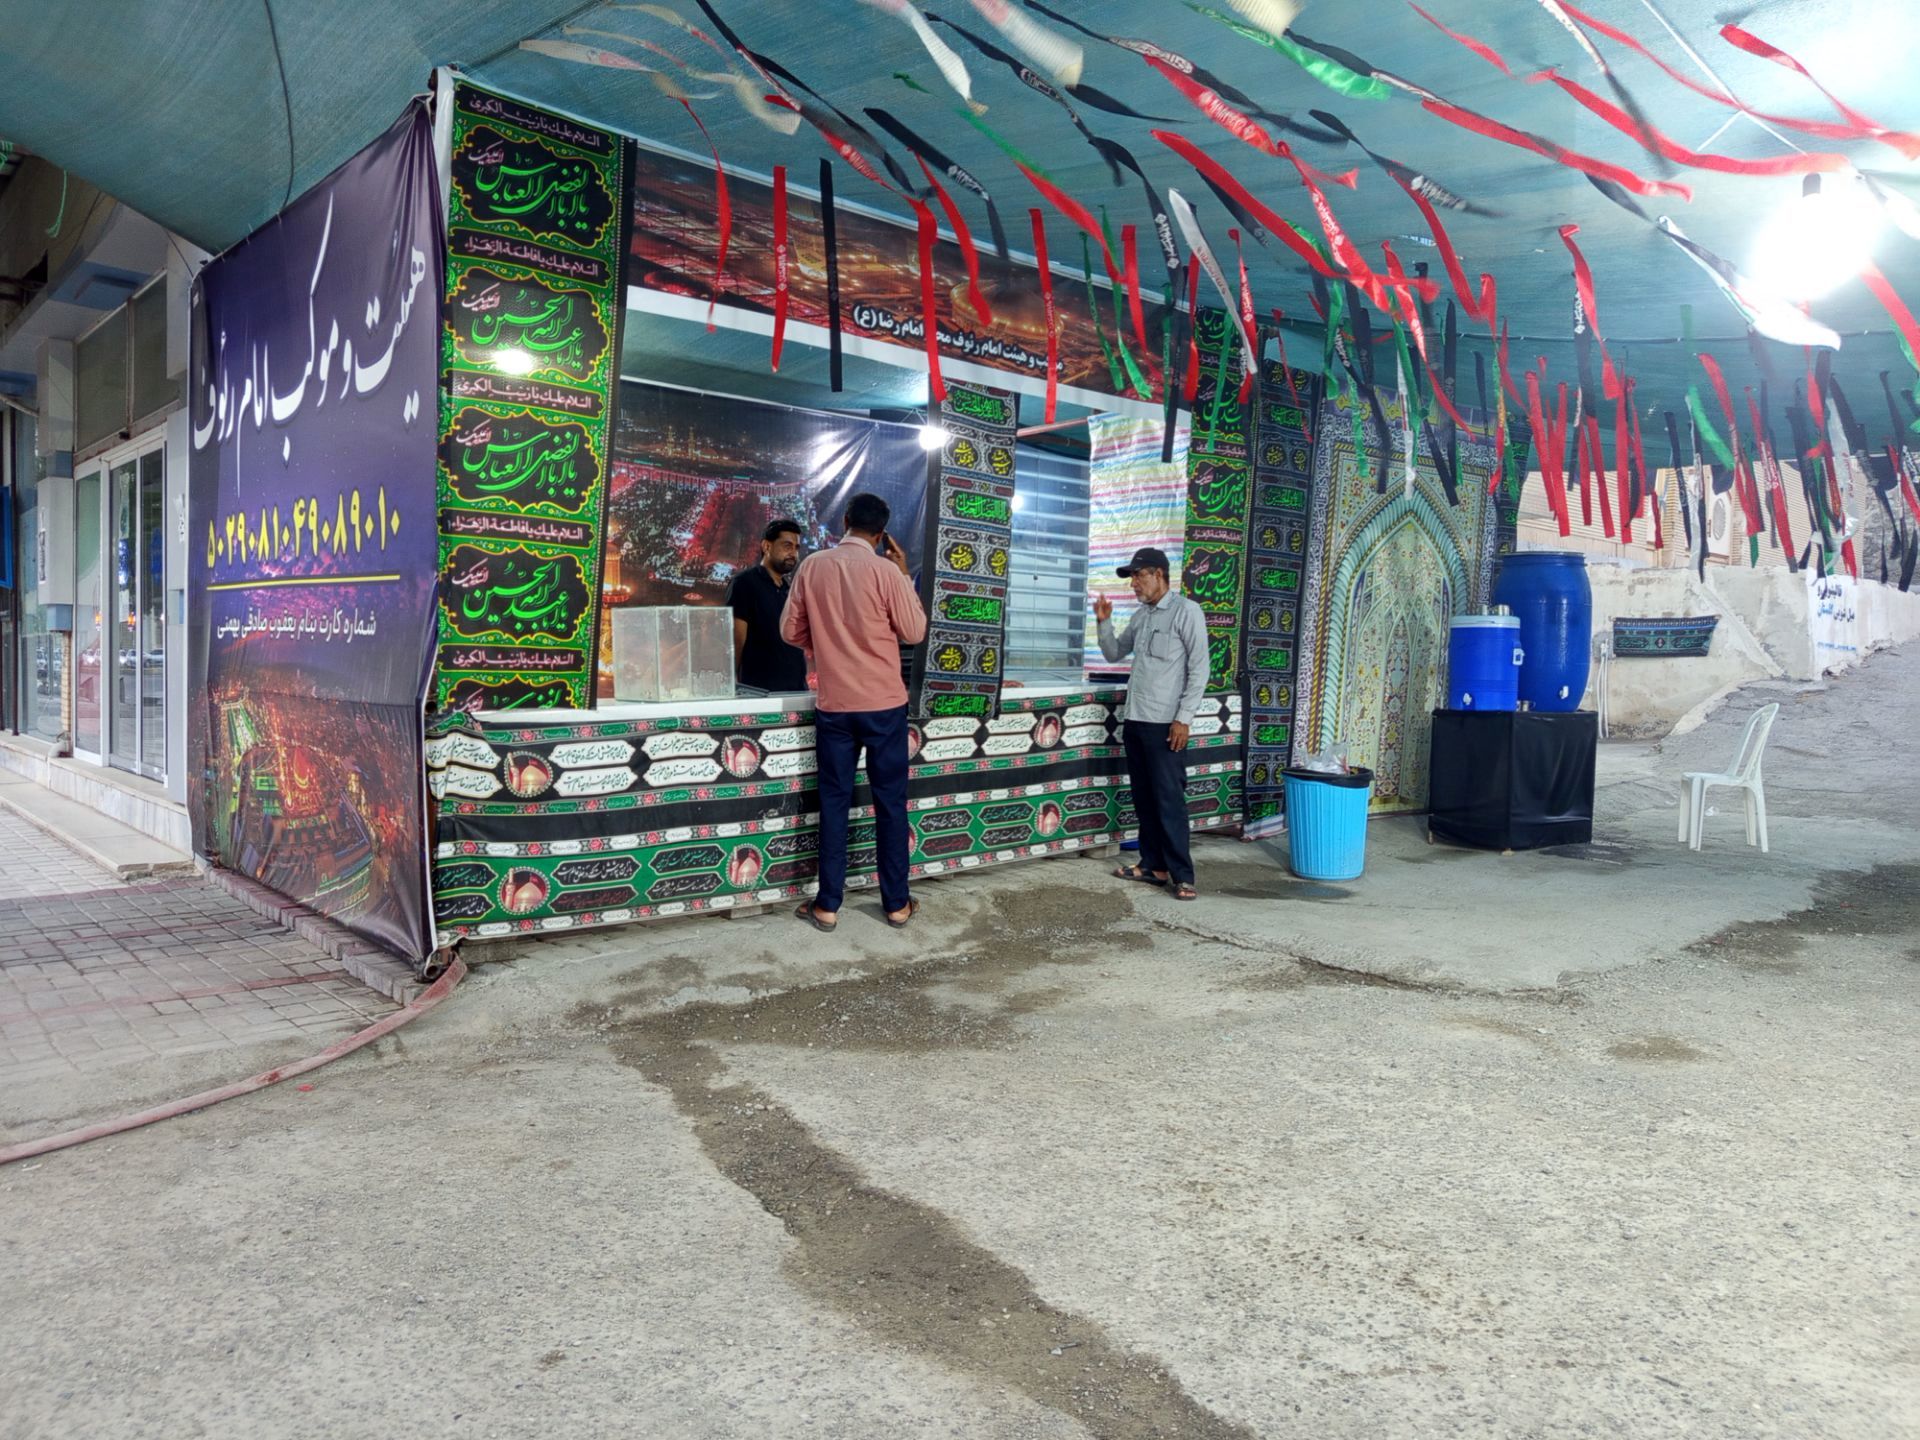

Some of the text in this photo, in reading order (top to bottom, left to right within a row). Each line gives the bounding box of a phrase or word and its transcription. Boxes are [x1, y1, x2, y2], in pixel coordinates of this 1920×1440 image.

[272, 190, 339, 462] موکب
[853, 305, 877, 328] (ع)
[879, 312, 900, 335] رضا
[901, 320, 924, 337] امام
[952, 332, 980, 354] رئوف
[981, 340, 1001, 356] امام
[340, 339, 352, 400] و
[1028, 357, 1035, 367] و
[236, 342, 268, 498] امام
[242, 607, 267, 638] صادقی
[269, 608, 296, 638] یعقوب
[297, 610, 316, 640] بنام
[319, 608, 343, 642] کارت
[344, 609, 376, 643] شماره
